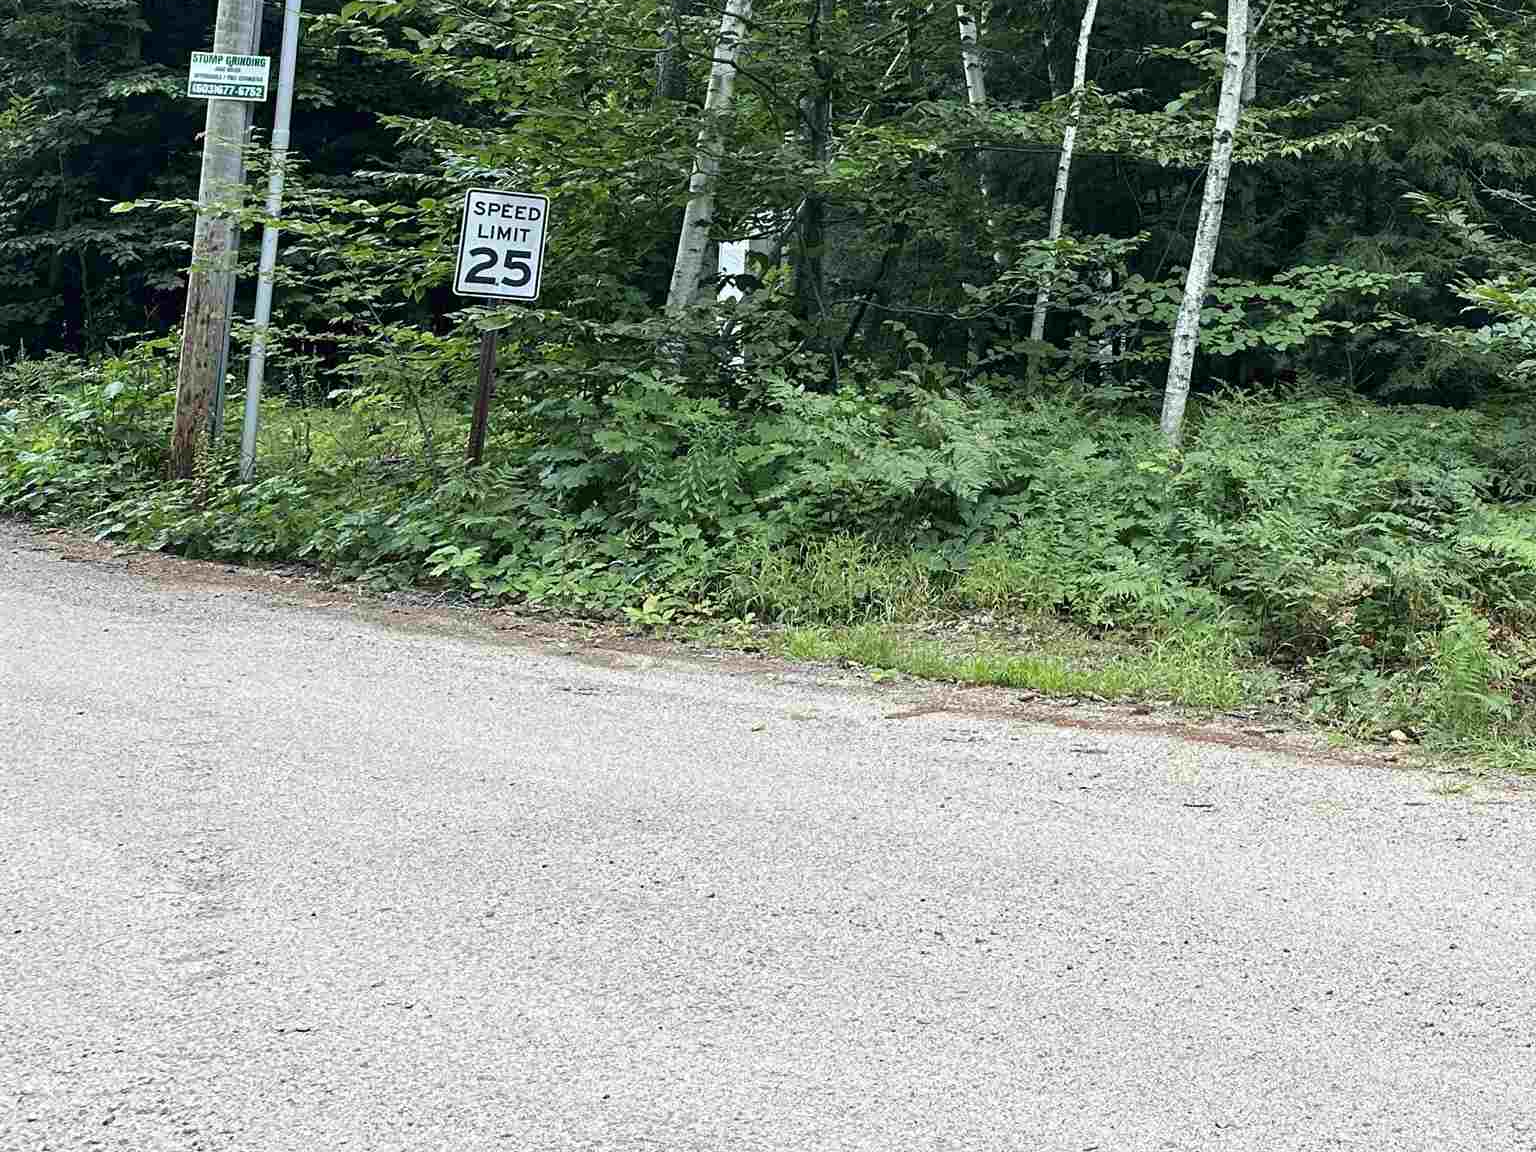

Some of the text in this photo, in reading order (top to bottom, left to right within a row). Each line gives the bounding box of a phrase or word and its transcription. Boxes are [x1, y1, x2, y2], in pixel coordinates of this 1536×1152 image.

[193, 54, 266, 67] STUMP GRINDING
[473, 201, 541, 221] SPEED
[478, 224, 531, 242] LIMIT
[464, 247, 531, 287] 25
